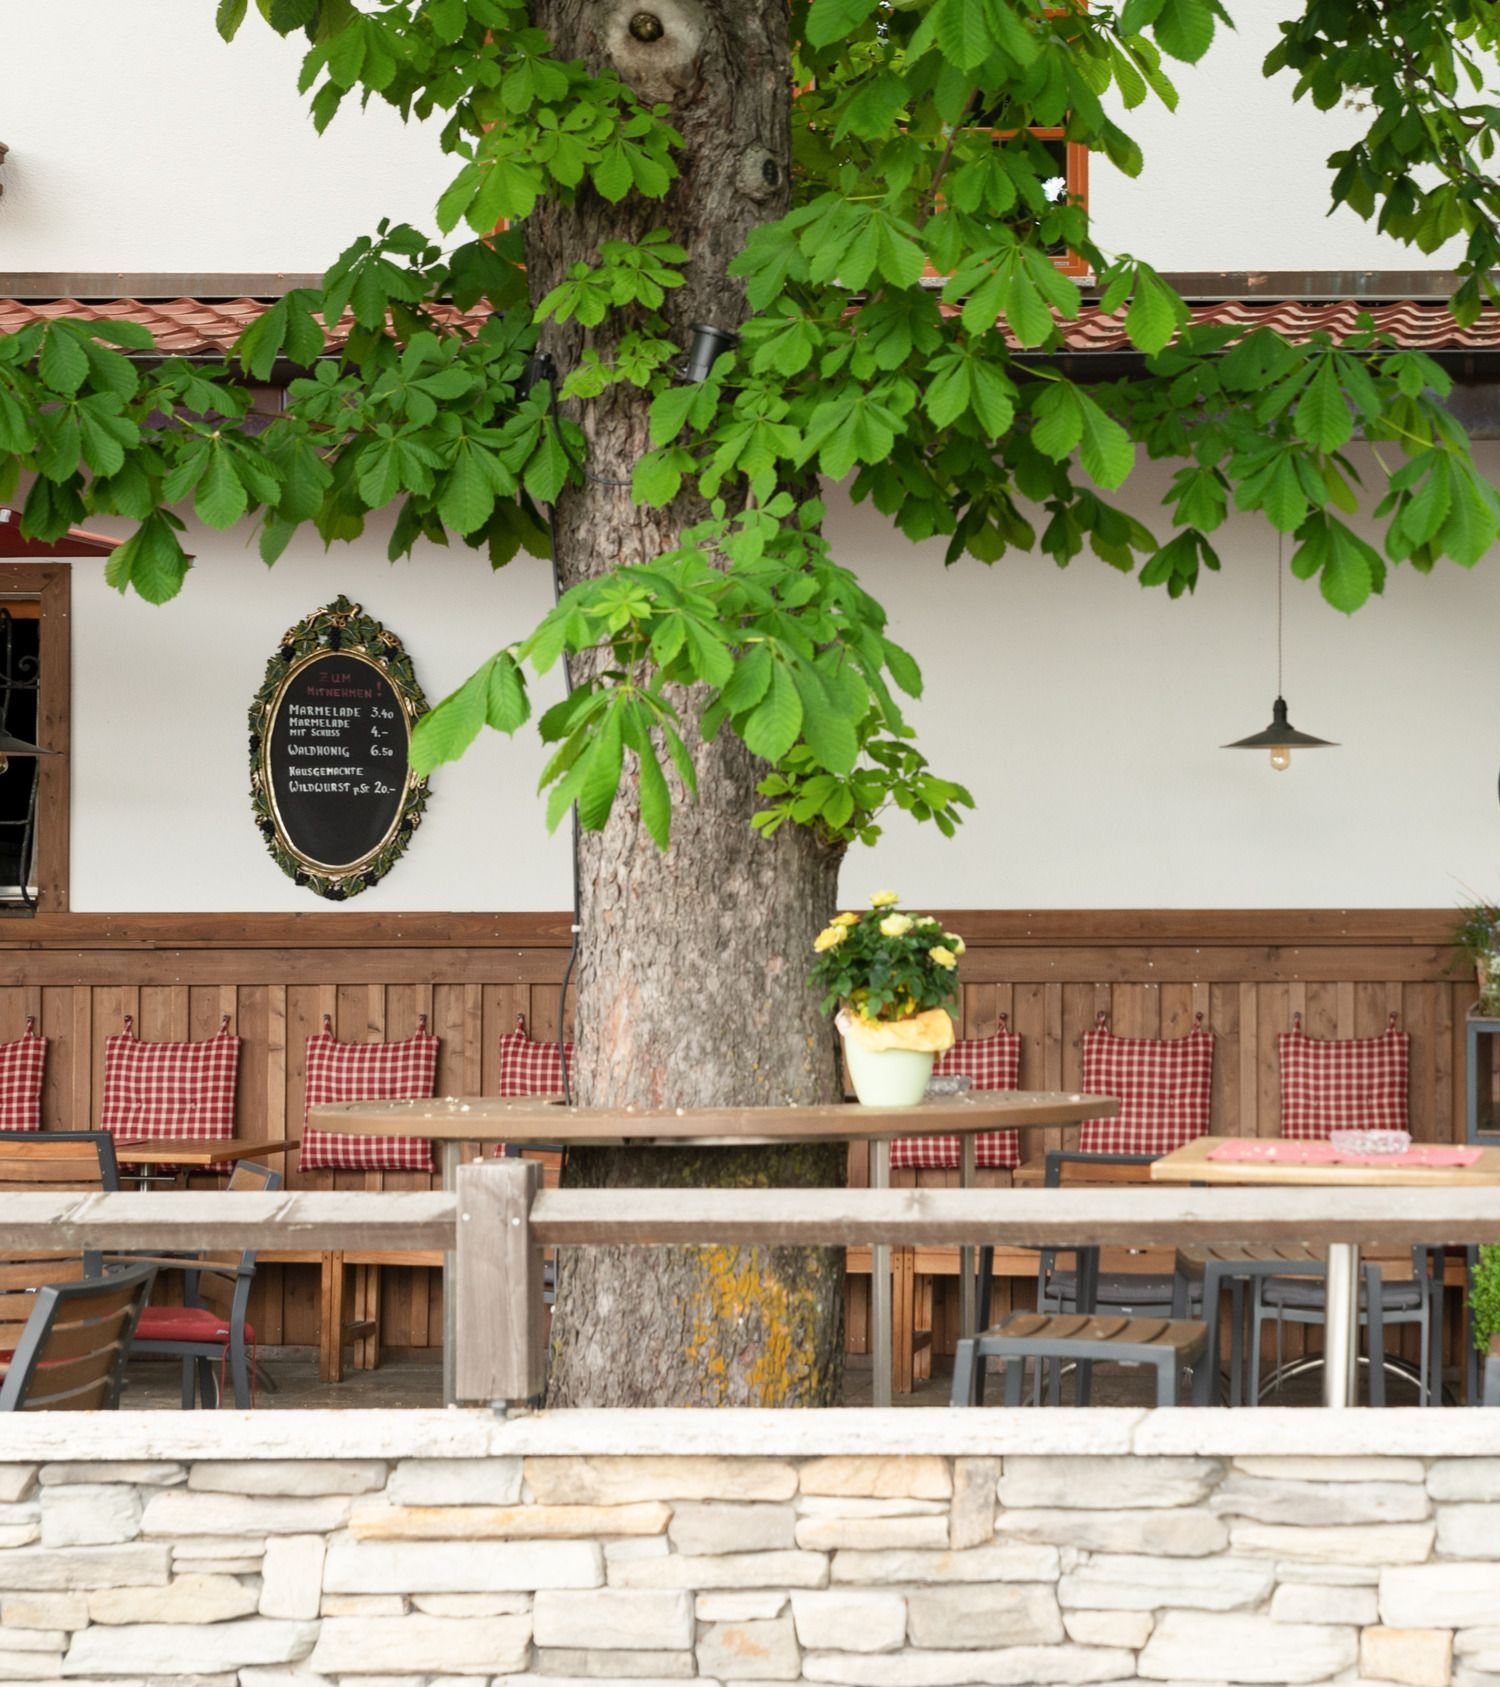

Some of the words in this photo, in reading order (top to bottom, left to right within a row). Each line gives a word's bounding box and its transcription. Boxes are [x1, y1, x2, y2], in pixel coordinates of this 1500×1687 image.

[320, 672, 351, 683] ZUM
[289, 704, 361, 717] MARMELADE
[370, 706, 394, 719] 3.40
[289, 717, 350, 728] MARMELADE
[288, 744, 350, 757] WALDHONIG
[370, 745, 393, 756] 6.50
[289, 766, 364, 776] HAUSGEMACHTE
[289, 780, 351, 792] WILDWURST
